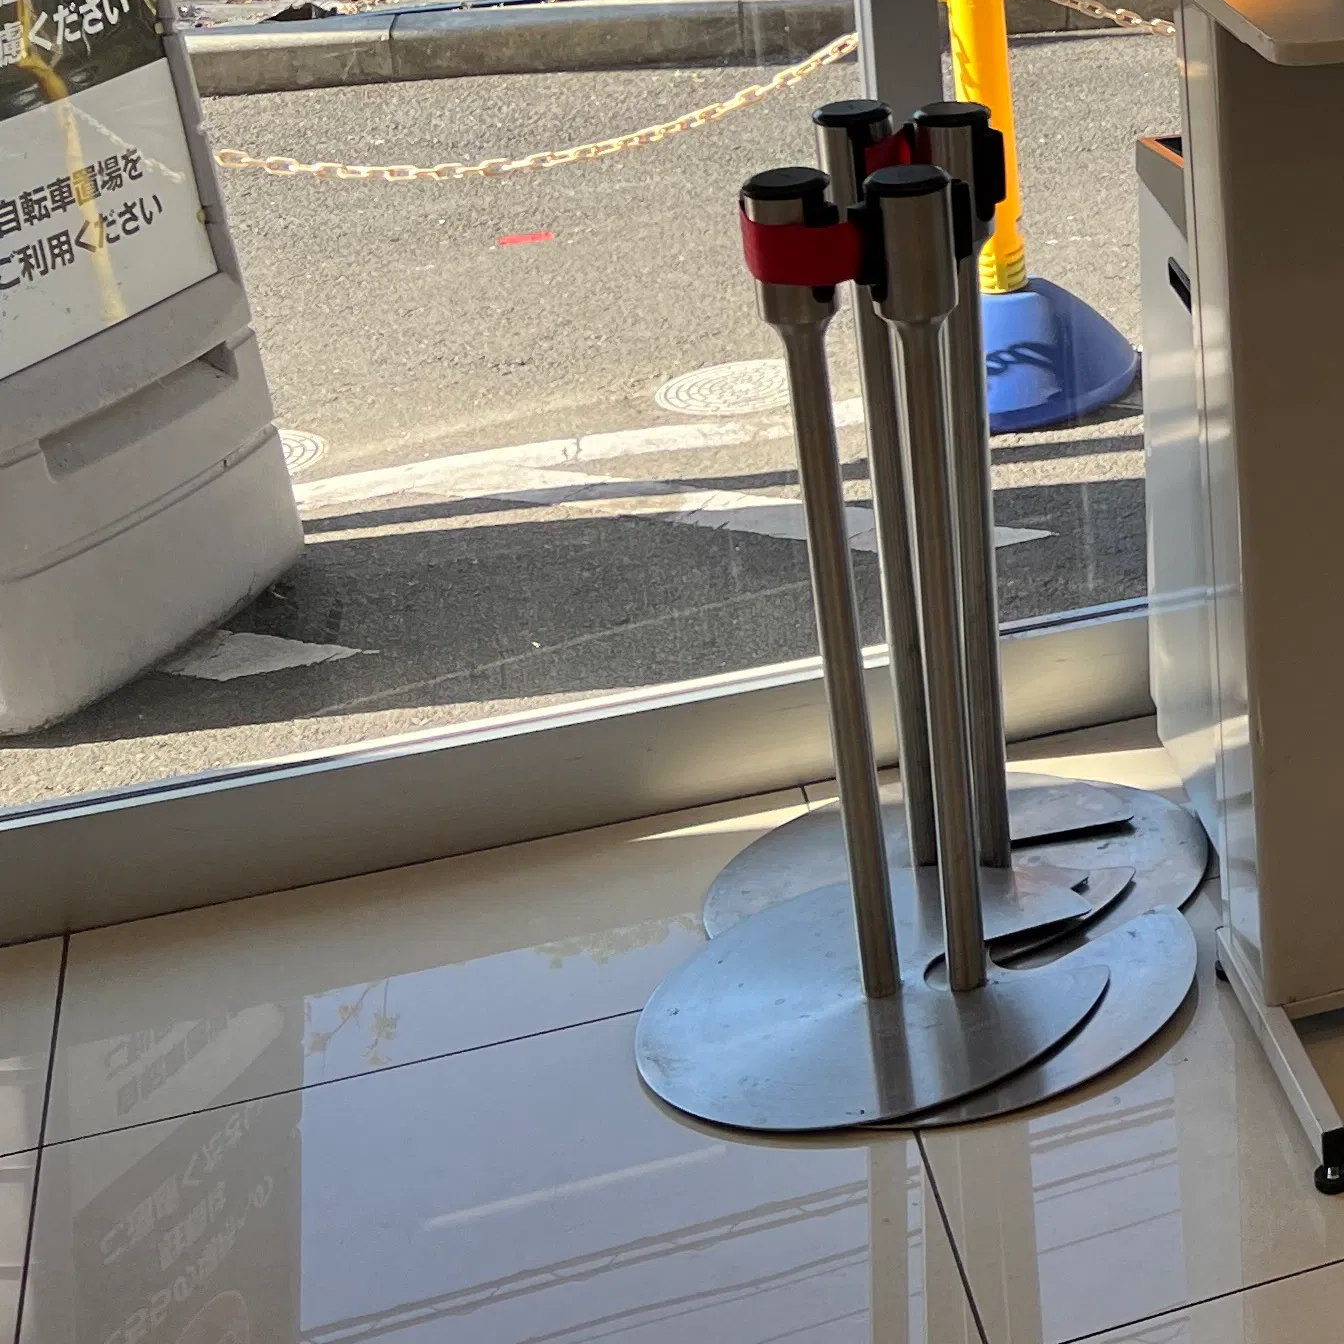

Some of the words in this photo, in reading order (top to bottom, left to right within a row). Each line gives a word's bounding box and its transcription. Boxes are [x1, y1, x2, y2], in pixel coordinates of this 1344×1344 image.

[0, 147, 144, 238] 自転車置場を
